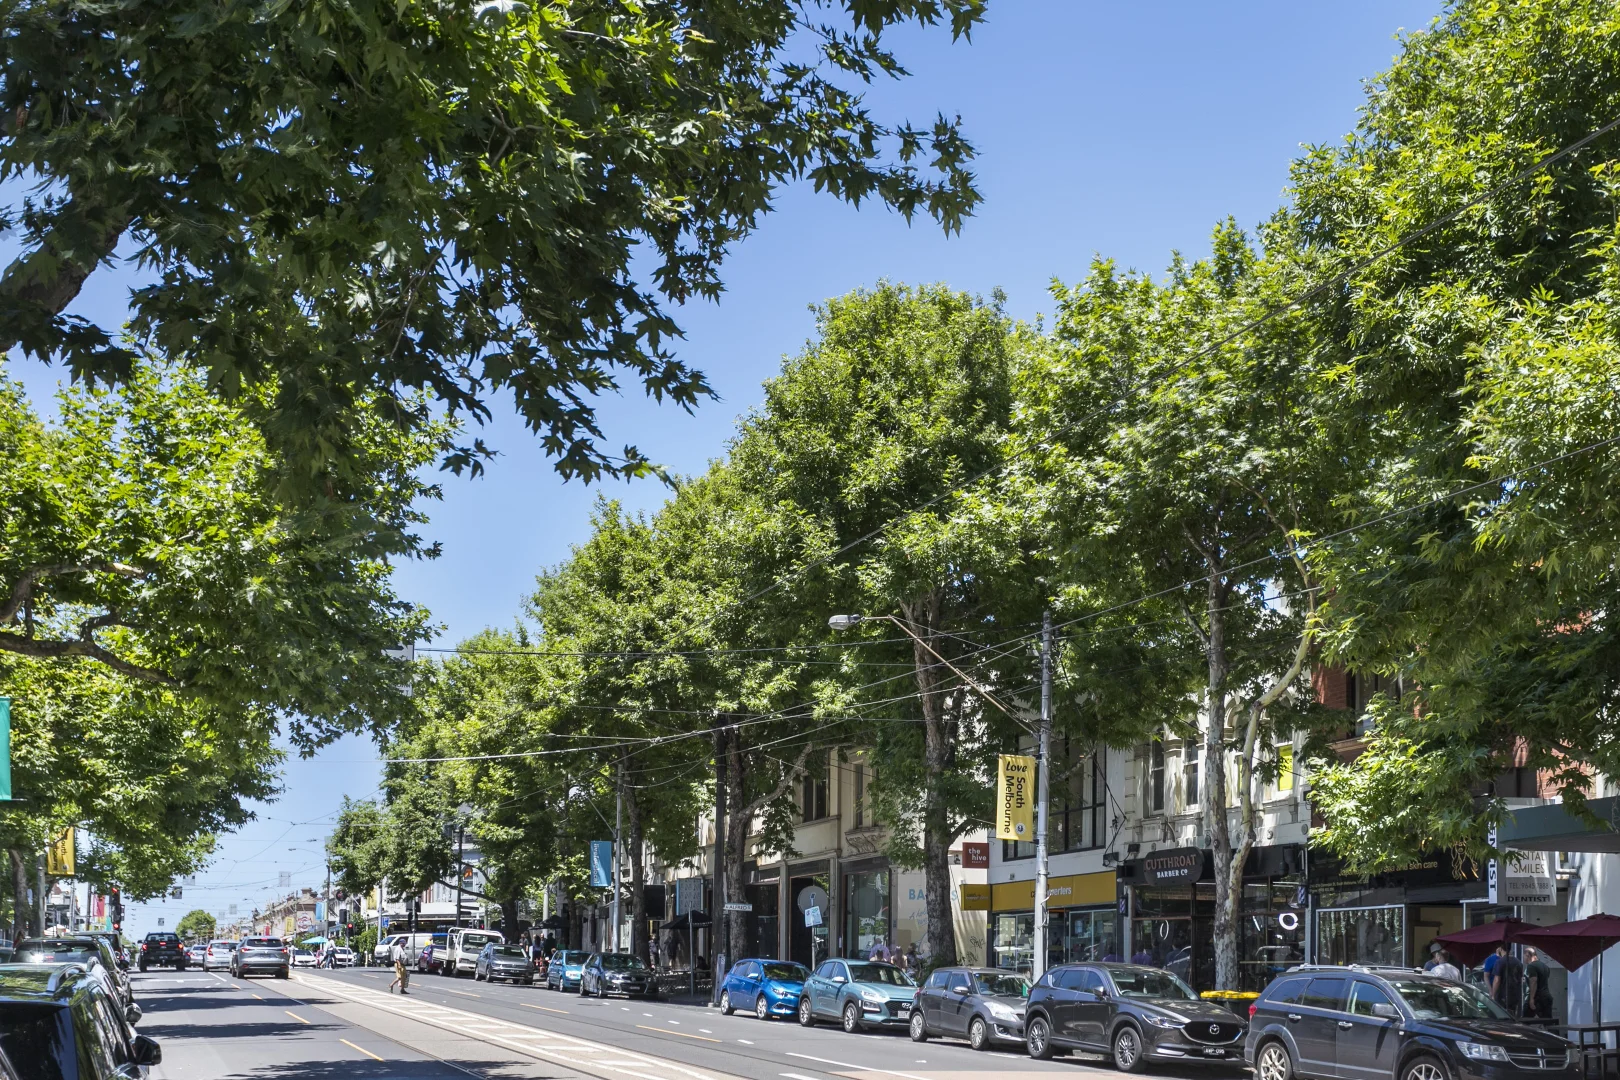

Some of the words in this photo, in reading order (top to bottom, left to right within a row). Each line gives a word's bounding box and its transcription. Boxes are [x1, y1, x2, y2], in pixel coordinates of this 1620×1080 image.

[1006, 761, 1028, 773] Love
[1016, 777, 1026, 808] South
[1004, 775, 1015, 834] Melbourne
[1515, 851, 1545, 861] ENTAL
[1145, 854, 1197, 871] CUTTHROAT
[1409, 861, 1423, 870] skin
[1423, 860, 1438, 869] care
[1156, 869, 1180, 879] BARBER
[1513, 863, 1546, 874] SMILES
